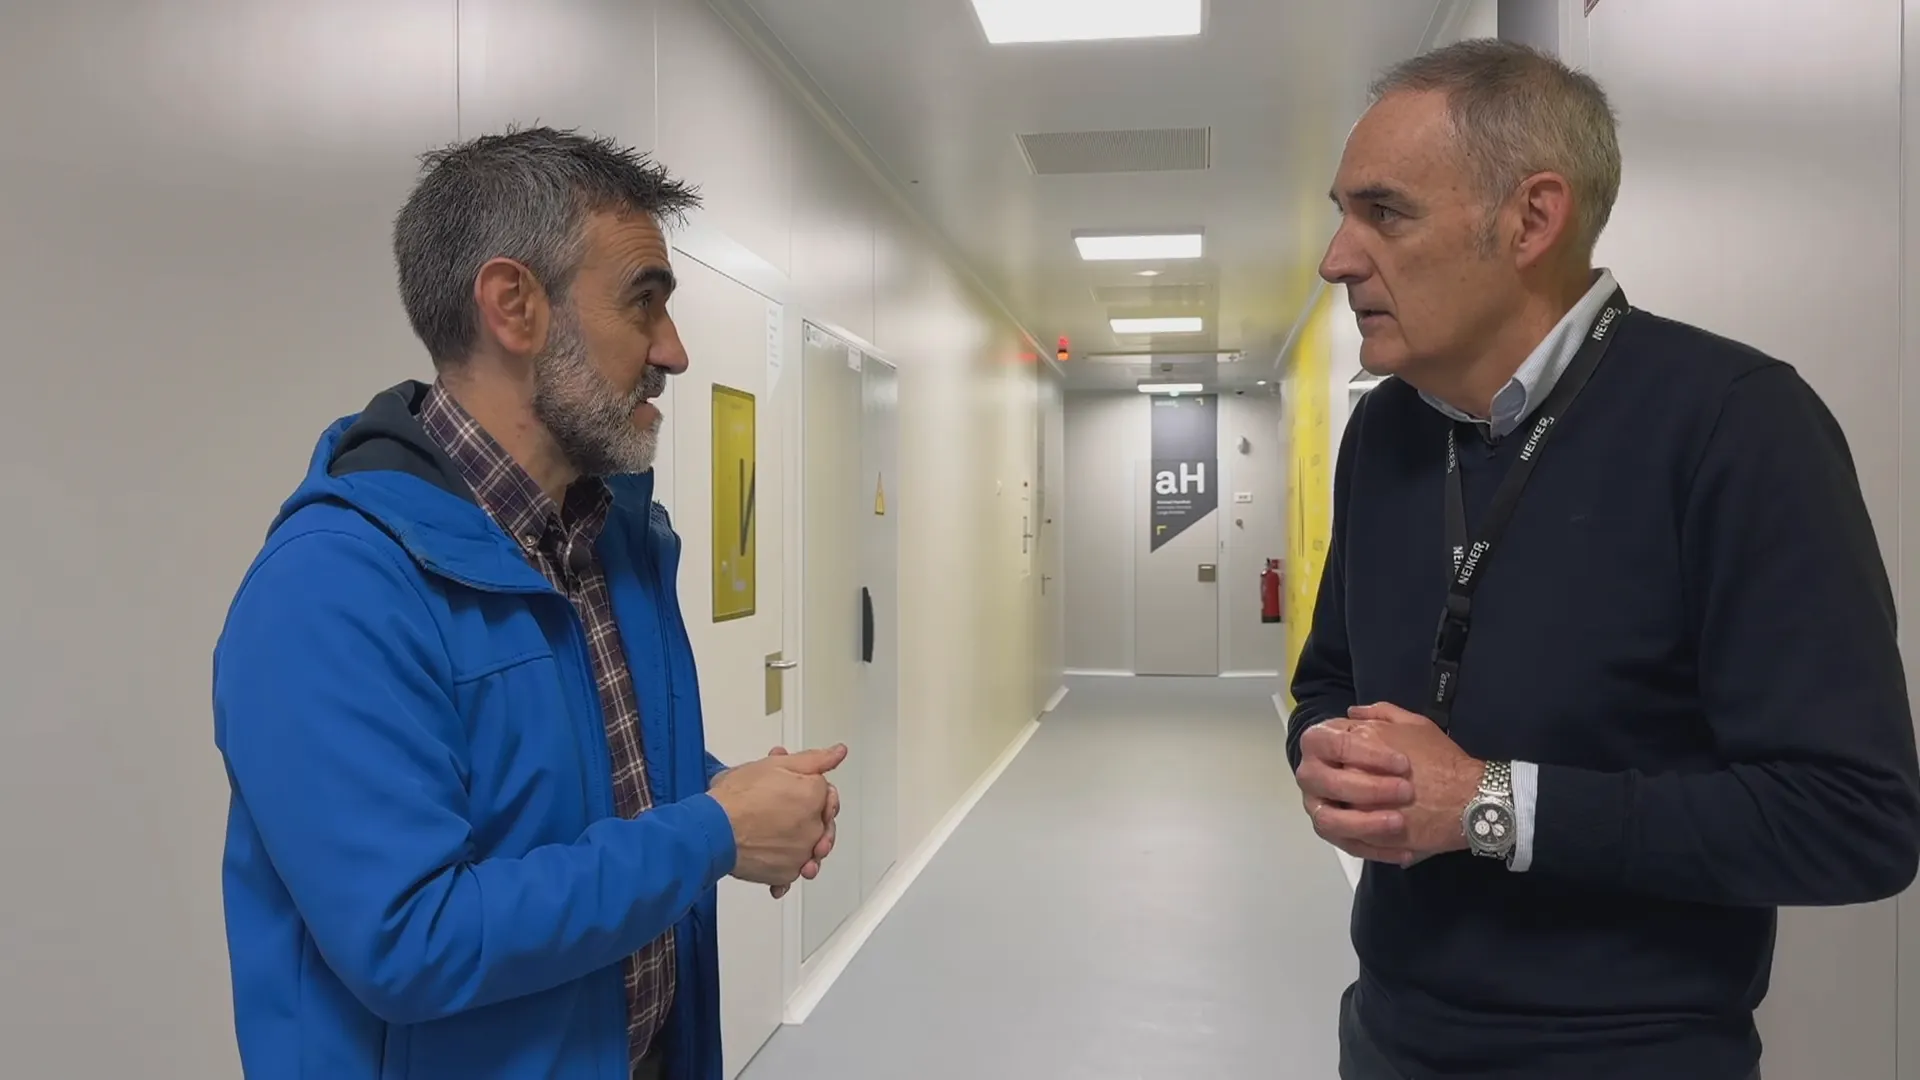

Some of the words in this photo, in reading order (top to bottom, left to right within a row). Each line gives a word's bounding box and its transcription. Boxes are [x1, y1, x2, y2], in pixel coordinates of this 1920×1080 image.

[1592, 307, 1617, 341] NEIKER
[1520, 417, 1549, 461] NEIKER
[1155, 462, 1204, 495] aH
[1458, 541, 1485, 586] NEIKER
